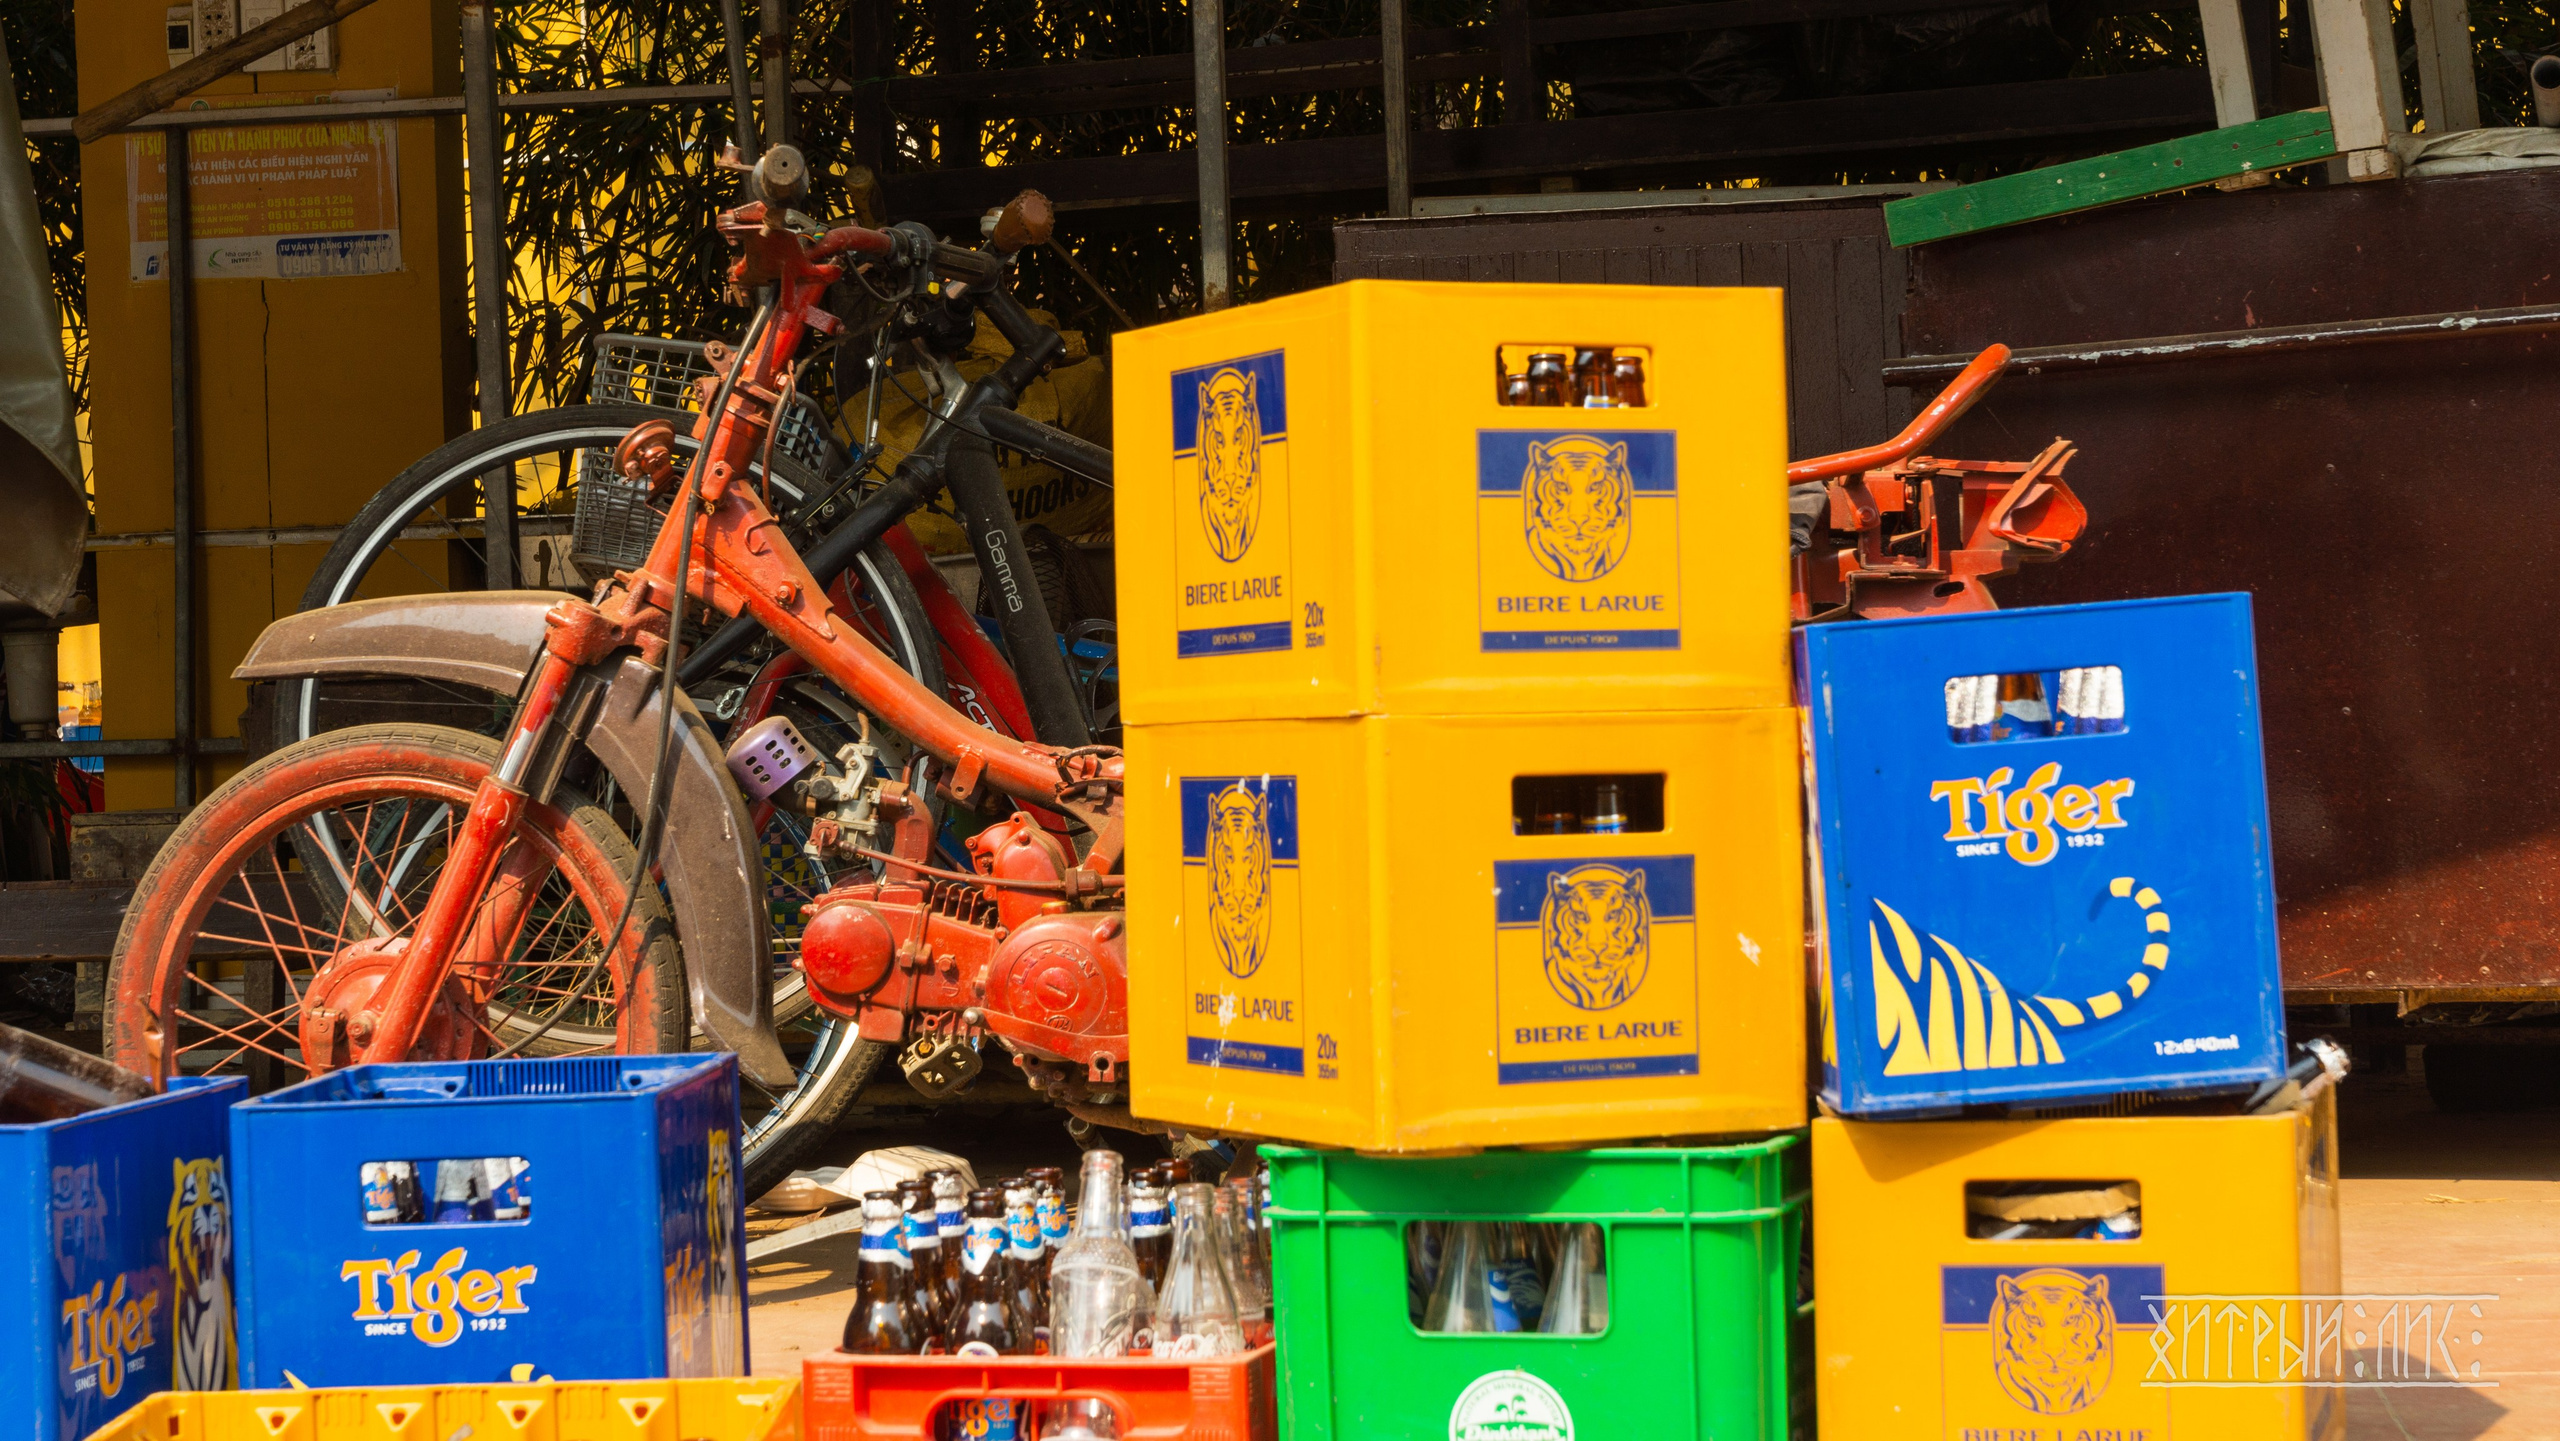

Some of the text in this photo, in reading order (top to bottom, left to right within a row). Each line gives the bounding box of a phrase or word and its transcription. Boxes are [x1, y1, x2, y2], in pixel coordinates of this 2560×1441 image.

[194, 129, 216, 153] YÊN
[237, 130, 271, 156] HẠNH
[272, 125, 304, 149] PHÚC
[210, 158, 236, 172] HIỆN
[238, 157, 258, 169] CÁC
[288, 154, 313, 168] HIỆN
[315, 154, 343, 165] NGHI
[344, 151, 369, 164] VẤN
[201, 173, 232, 185] HÀNH
[234, 174, 246, 184] VI
[248, 173, 260, 182] VI
[262, 171, 296, 184] PHẠM
[297, 167, 328, 180] PHÁP
[330, 165, 358, 180] LUẬT
[282, 254, 321, 275] 0905
[1186, 575, 1283, 607] BIERE LARUE
[1496, 594, 1665, 613] BIERE LARUE
[1304, 601, 1325, 628] 20x
[1212, 633, 1238, 646] DEPUIS
[1544, 635, 1588, 645] DEPUIS
[1930, 761, 2136, 867] Tiger
[1956, 833, 2105, 858] SINCE 1932
[1012, 944, 1100, 985] LIFAN
[1242, 997, 1294, 1022] LARUE
[1515, 1020, 1683, 1044] BIERE LARUE
[1317, 1032, 1338, 1060] 20x
[340, 1246, 538, 1348] Tiger
[62, 1272, 160, 1400] Tiger
[364, 1318, 507, 1336] SINCE 1932
